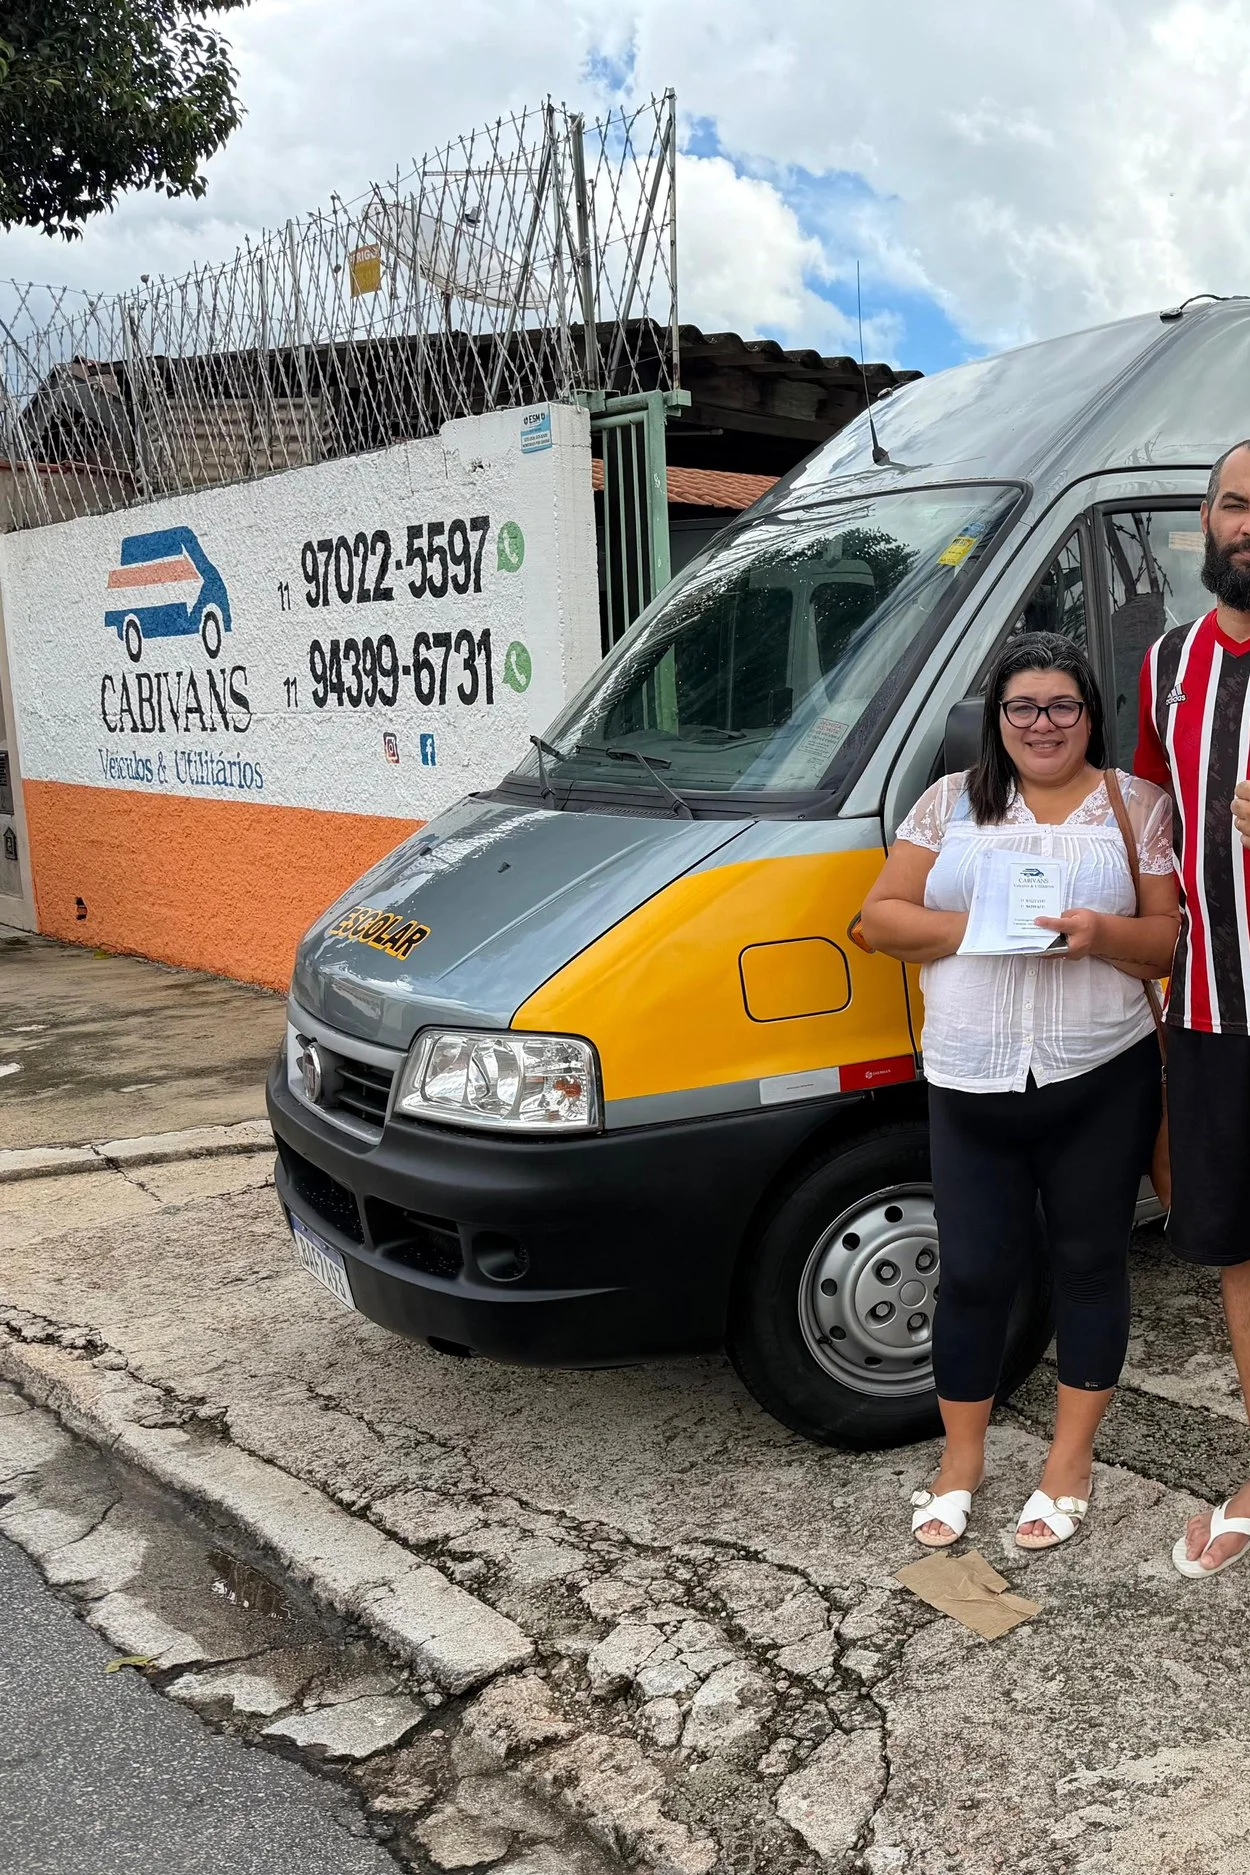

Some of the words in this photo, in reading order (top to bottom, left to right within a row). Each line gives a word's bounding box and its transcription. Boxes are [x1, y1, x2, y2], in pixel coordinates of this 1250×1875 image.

[277, 581, 291, 611] 11
[301, 515, 490, 608] 97022-5597
[100, 665, 252, 734] CABIVANS
[283, 677, 298, 708] 11
[309, 628, 494, 708] 94399-6731
[157, 751, 168, 784] &
[174, 750, 264, 789] Utilitários
[331, 906, 430, 959] ESCOLAR
